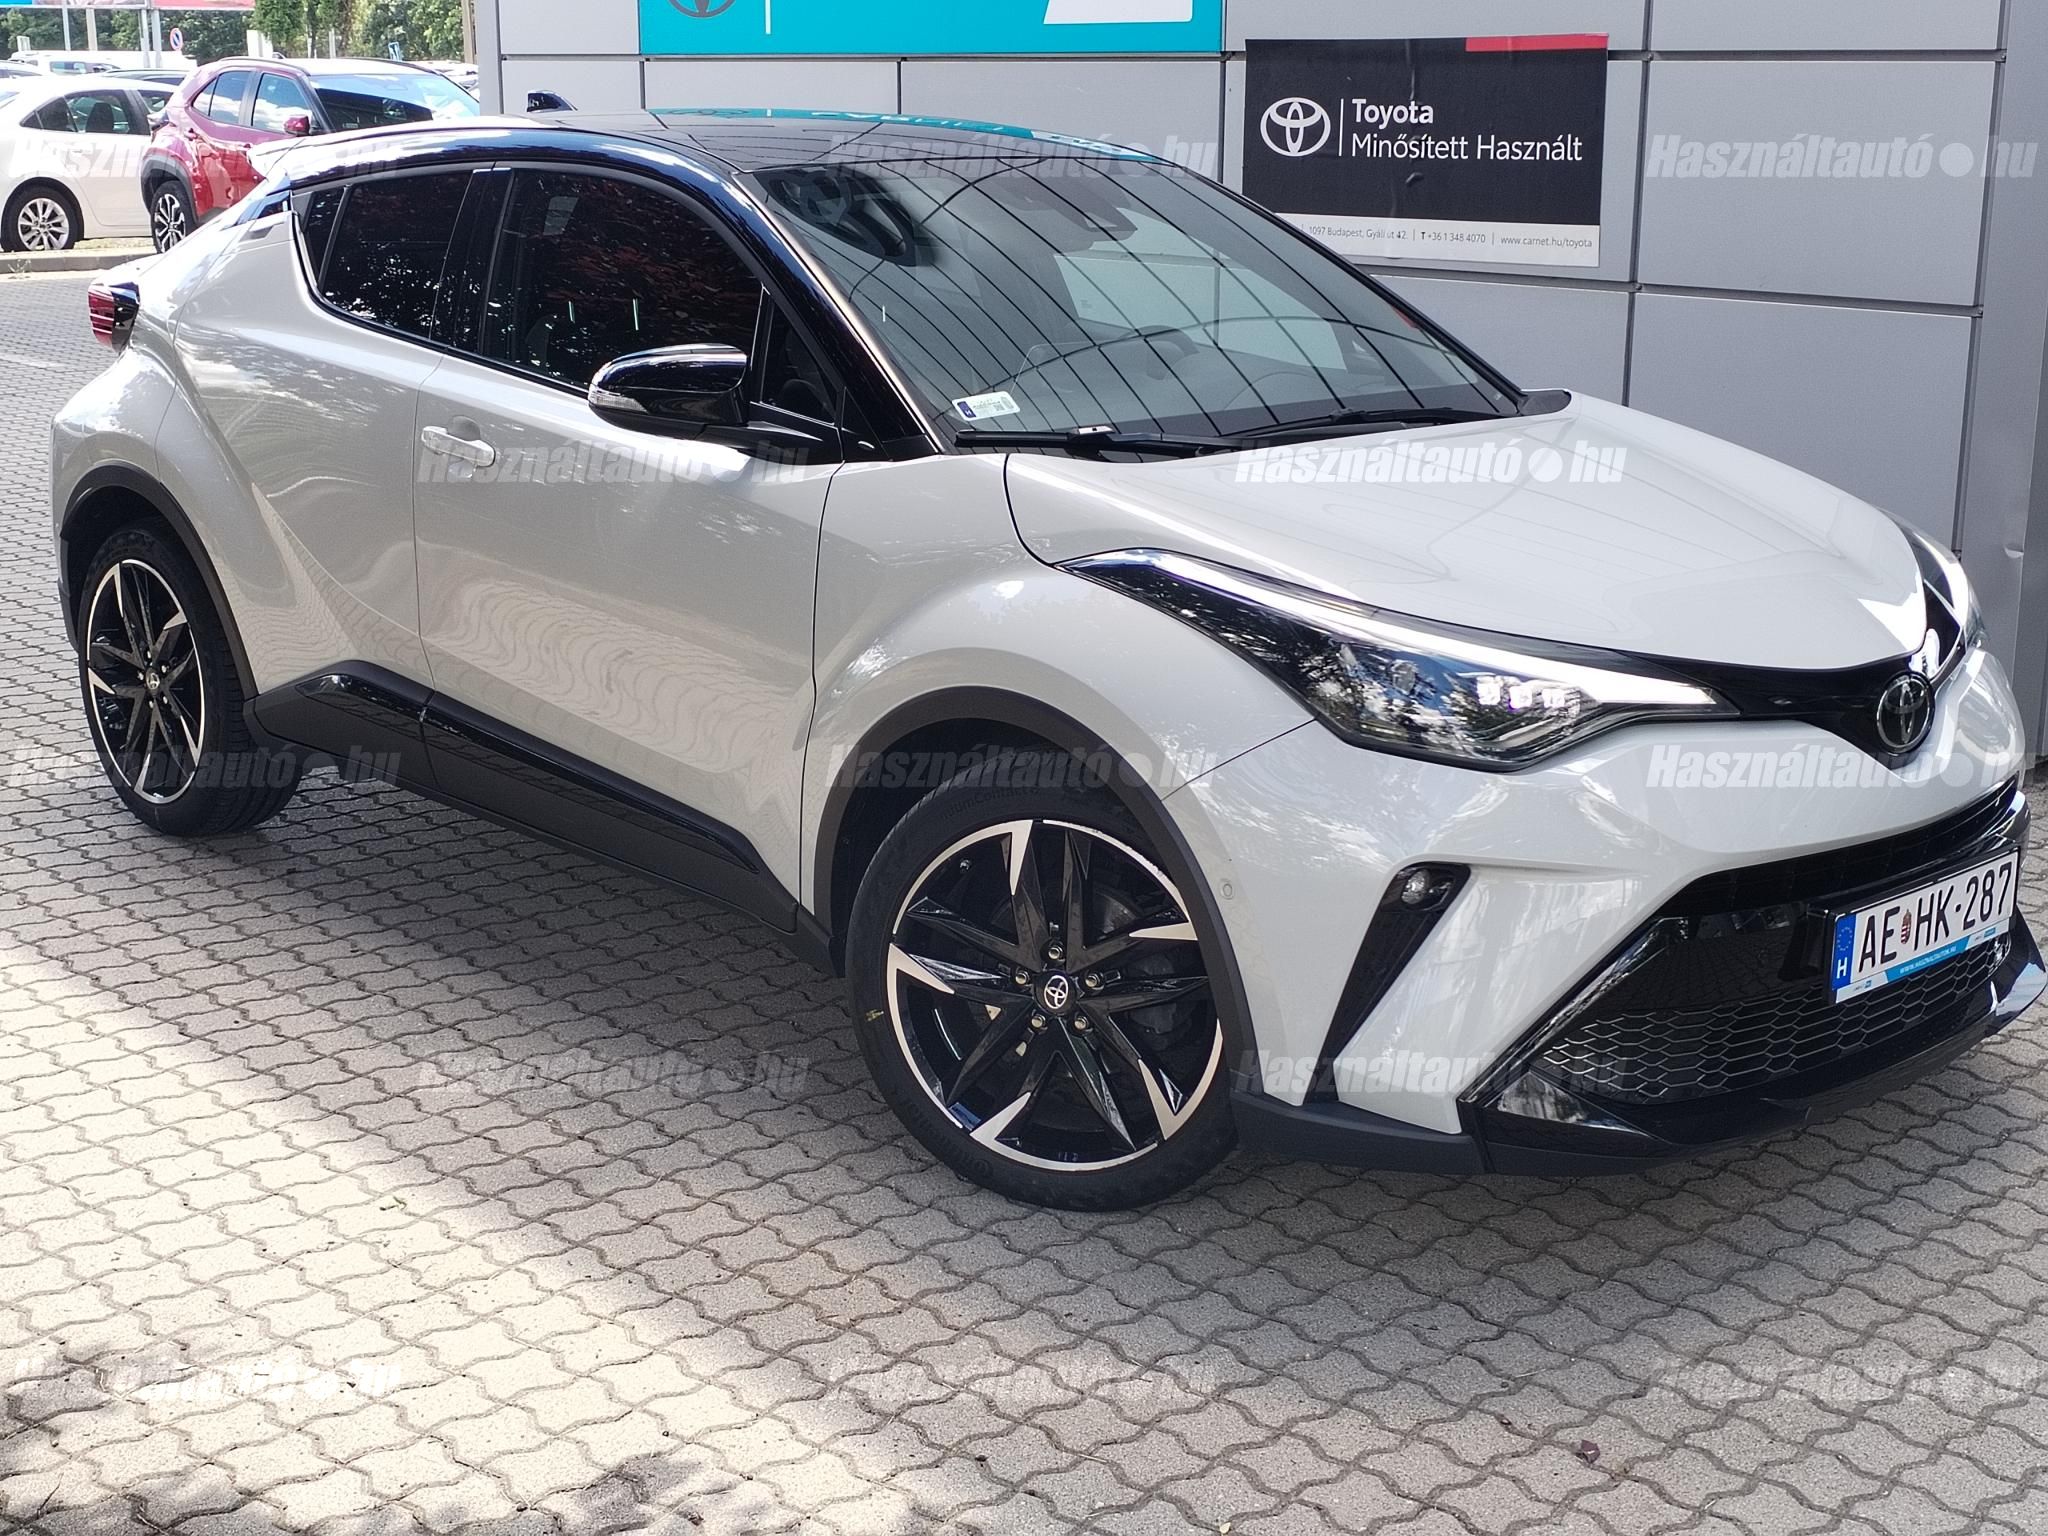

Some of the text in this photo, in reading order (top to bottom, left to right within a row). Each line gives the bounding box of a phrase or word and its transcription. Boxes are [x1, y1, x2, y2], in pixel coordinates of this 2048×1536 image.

[1351, 98, 1434, 130] Toyota
[1351, 132, 1583, 161] Minősített Használt
[1466, 233, 1486, 244] 4070
[1858, 906, 1901, 973] AE
[1836, 957, 1848, 979] H
